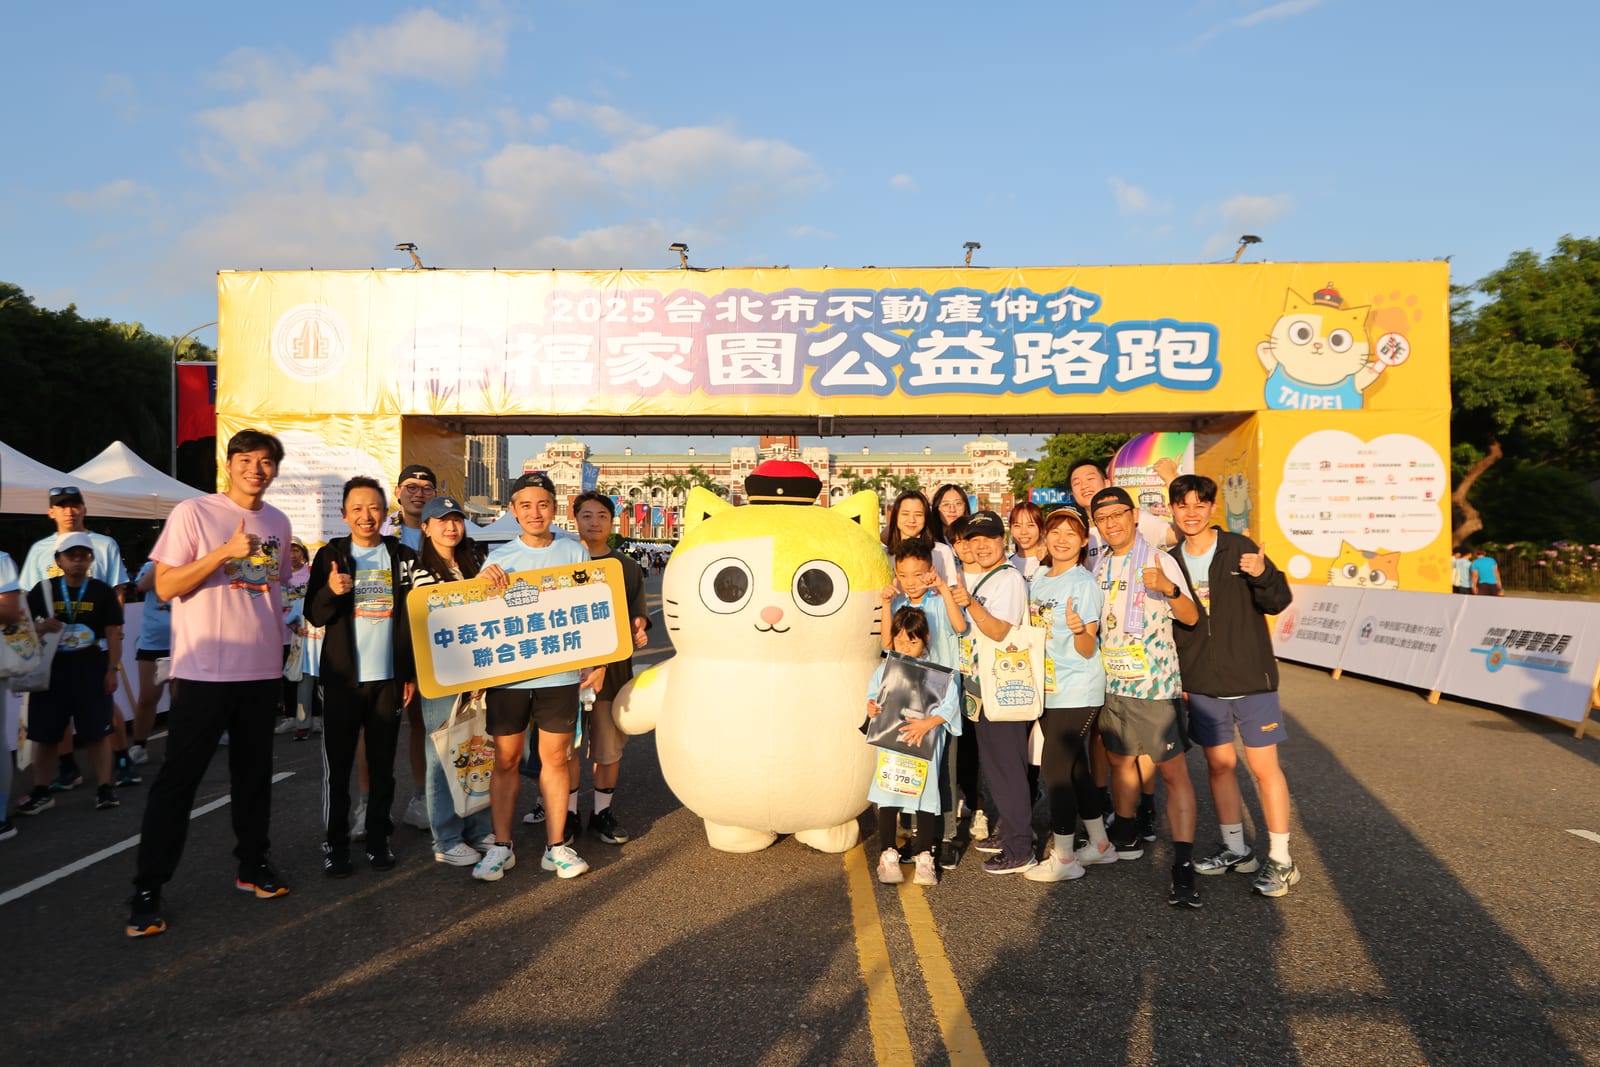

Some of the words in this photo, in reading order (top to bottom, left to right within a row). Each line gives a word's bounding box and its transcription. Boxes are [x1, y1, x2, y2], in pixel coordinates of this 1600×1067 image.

[1278, 385, 1343, 410] TAIPEI
[433, 600, 611, 649] 中泰不動產估價師
[473, 630, 582, 669] 聯合事務所
